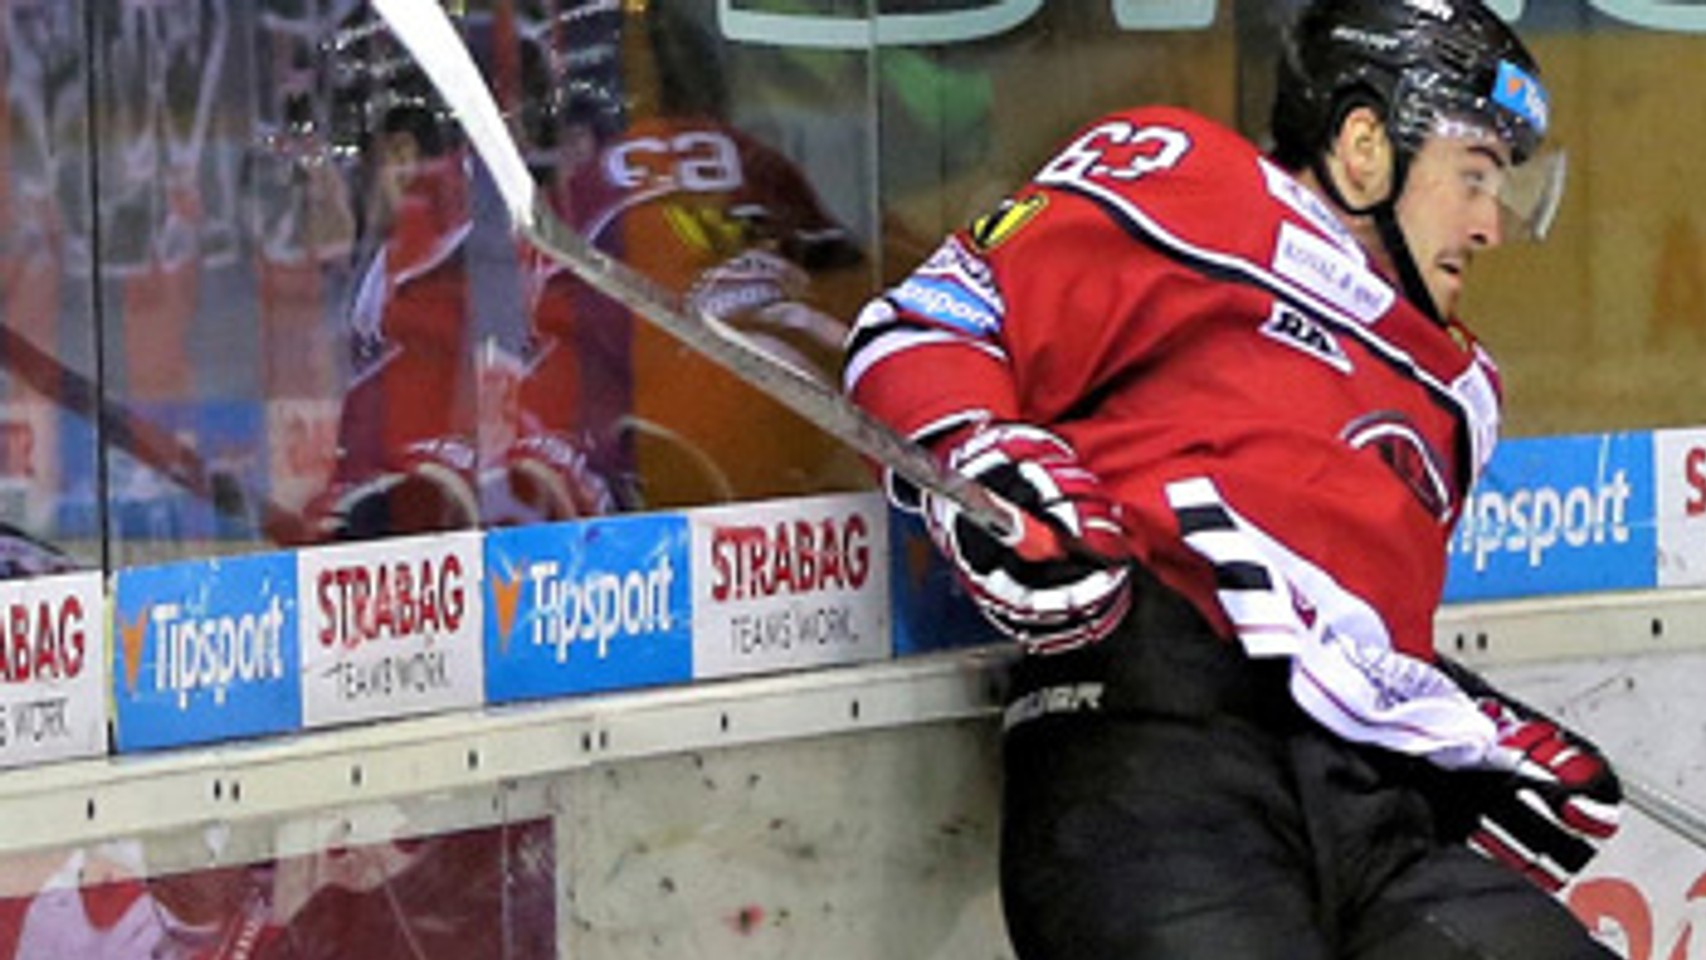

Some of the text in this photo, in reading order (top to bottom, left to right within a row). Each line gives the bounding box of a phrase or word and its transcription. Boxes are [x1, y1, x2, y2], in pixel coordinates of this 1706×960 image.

[1033, 121, 1193, 184] 63
[711, 514, 870, 601] STRABAG
[1446, 468, 1632, 571] ipsport
[318, 553, 465, 648] STRABAG
[531, 554, 673, 663] Tipsport
[153, 594, 284, 710] Tipsport
